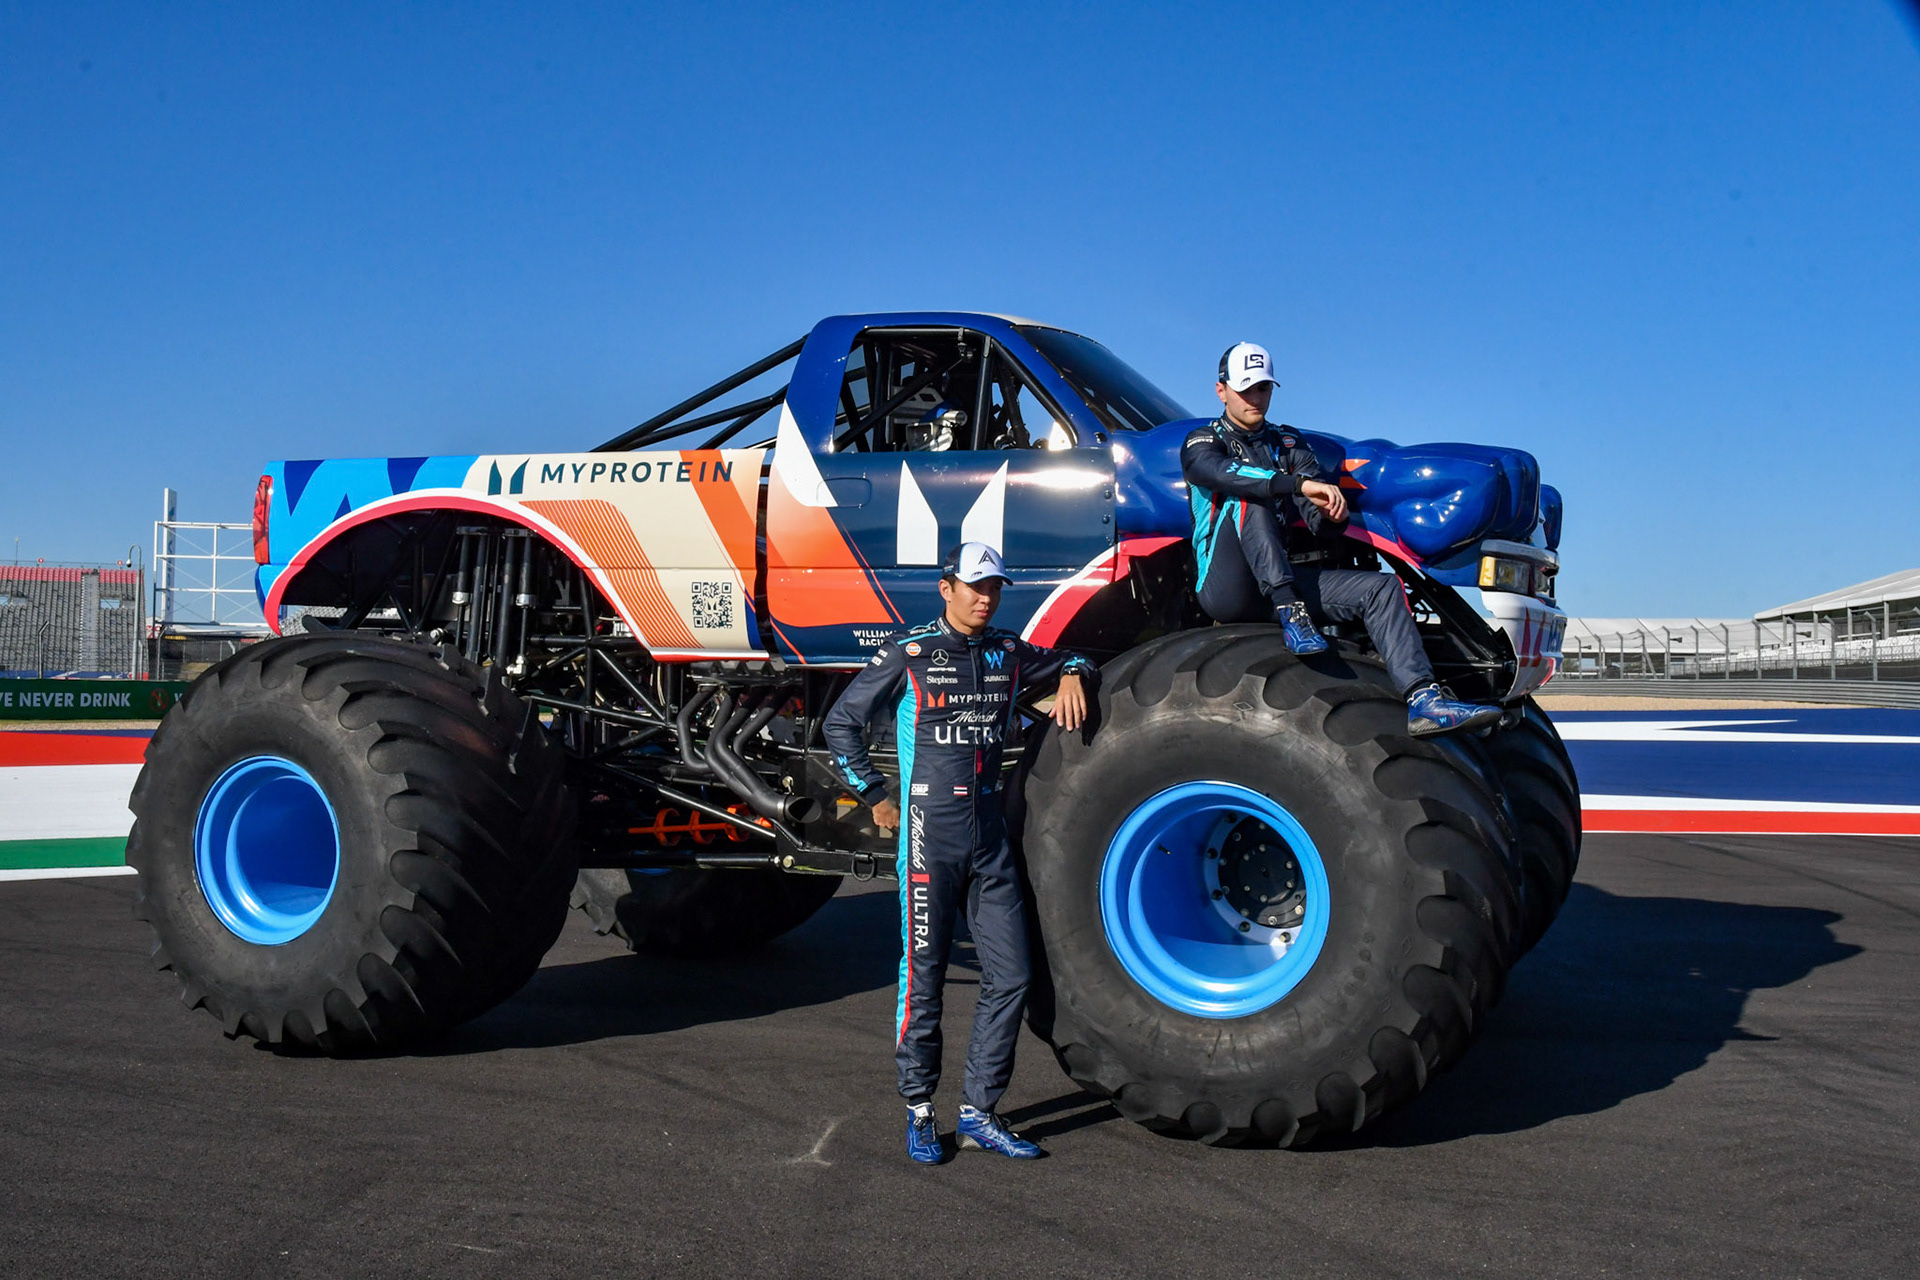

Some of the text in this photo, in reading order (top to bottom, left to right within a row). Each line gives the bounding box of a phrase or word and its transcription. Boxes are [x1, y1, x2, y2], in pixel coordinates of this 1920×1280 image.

[540, 460, 734, 484] MYPROTEIN
[852, 629, 896, 639] WILLIAM
[858, 638, 884, 647] RACI
[926, 675, 959, 686] Stephens
[19, 692, 74, 707] NEVER
[80, 692, 131, 707] DRINK
[948, 693, 1009, 704] MYPROTEIN
[934, 725, 1003, 745] ULTRA
[910, 804, 929, 951] Michelob ULTRA
